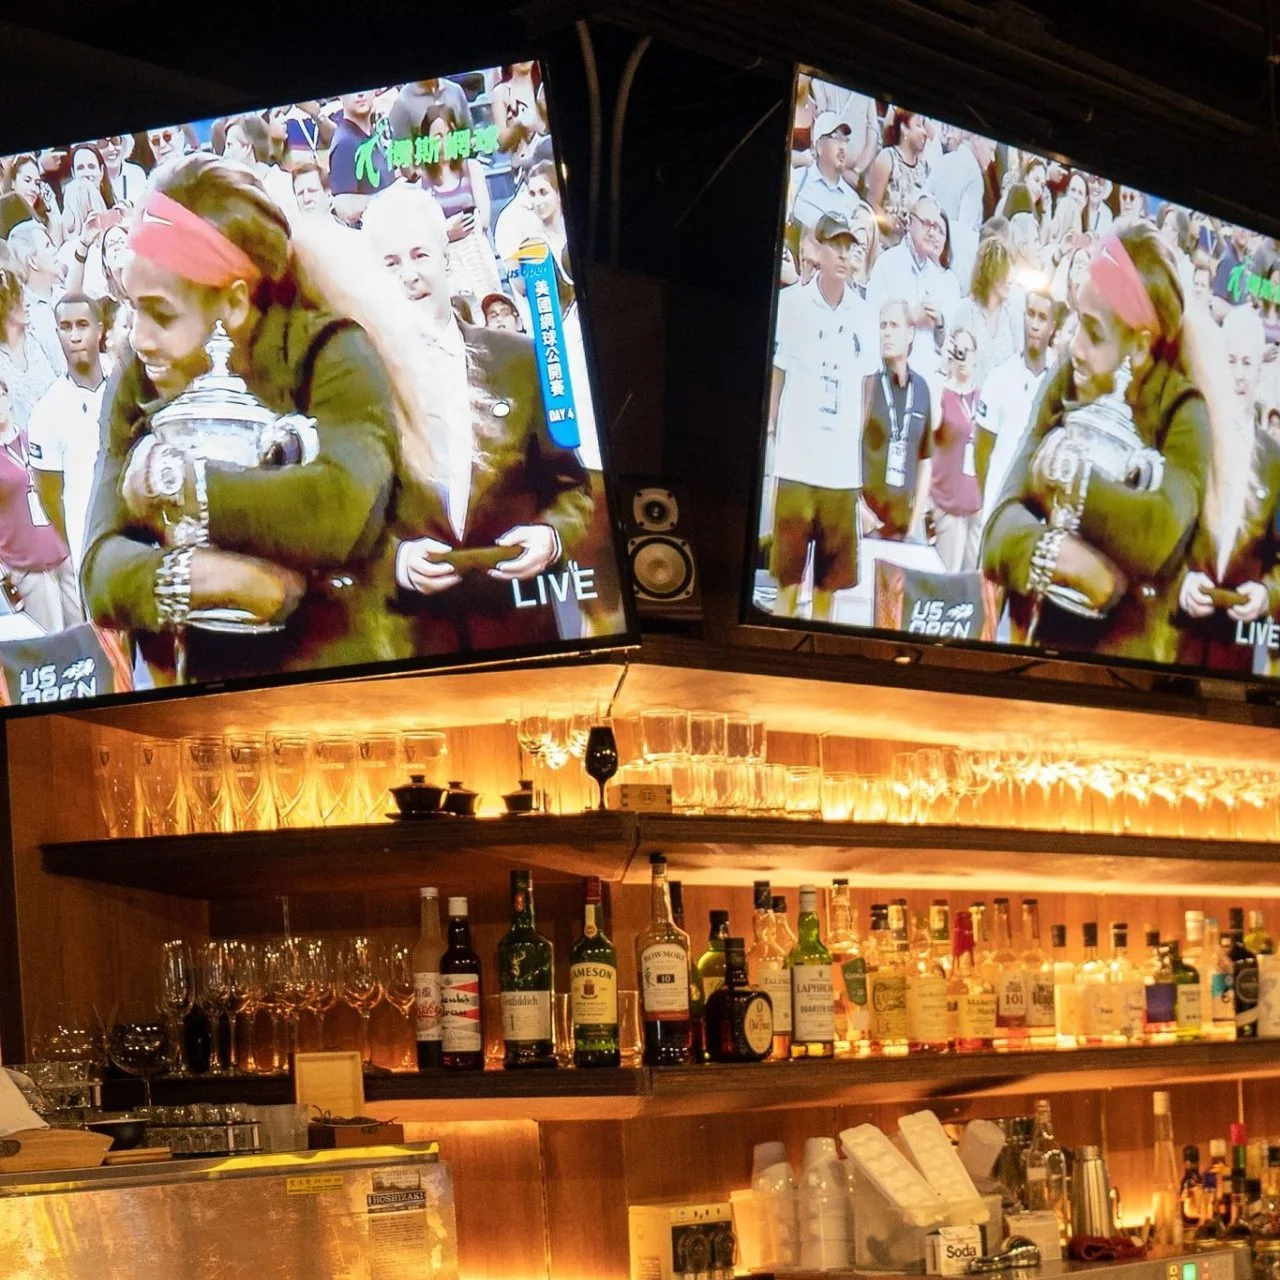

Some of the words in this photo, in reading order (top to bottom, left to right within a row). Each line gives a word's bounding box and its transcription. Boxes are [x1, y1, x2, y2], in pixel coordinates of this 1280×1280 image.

[549, 408, 566, 423] DAY
[511, 568, 598, 608] LIVE
[913, 600, 944, 620] US
[20, 664, 57, 691] US
[571, 966, 612, 980] AMESON
[946, 1243, 977, 1259] Soda
